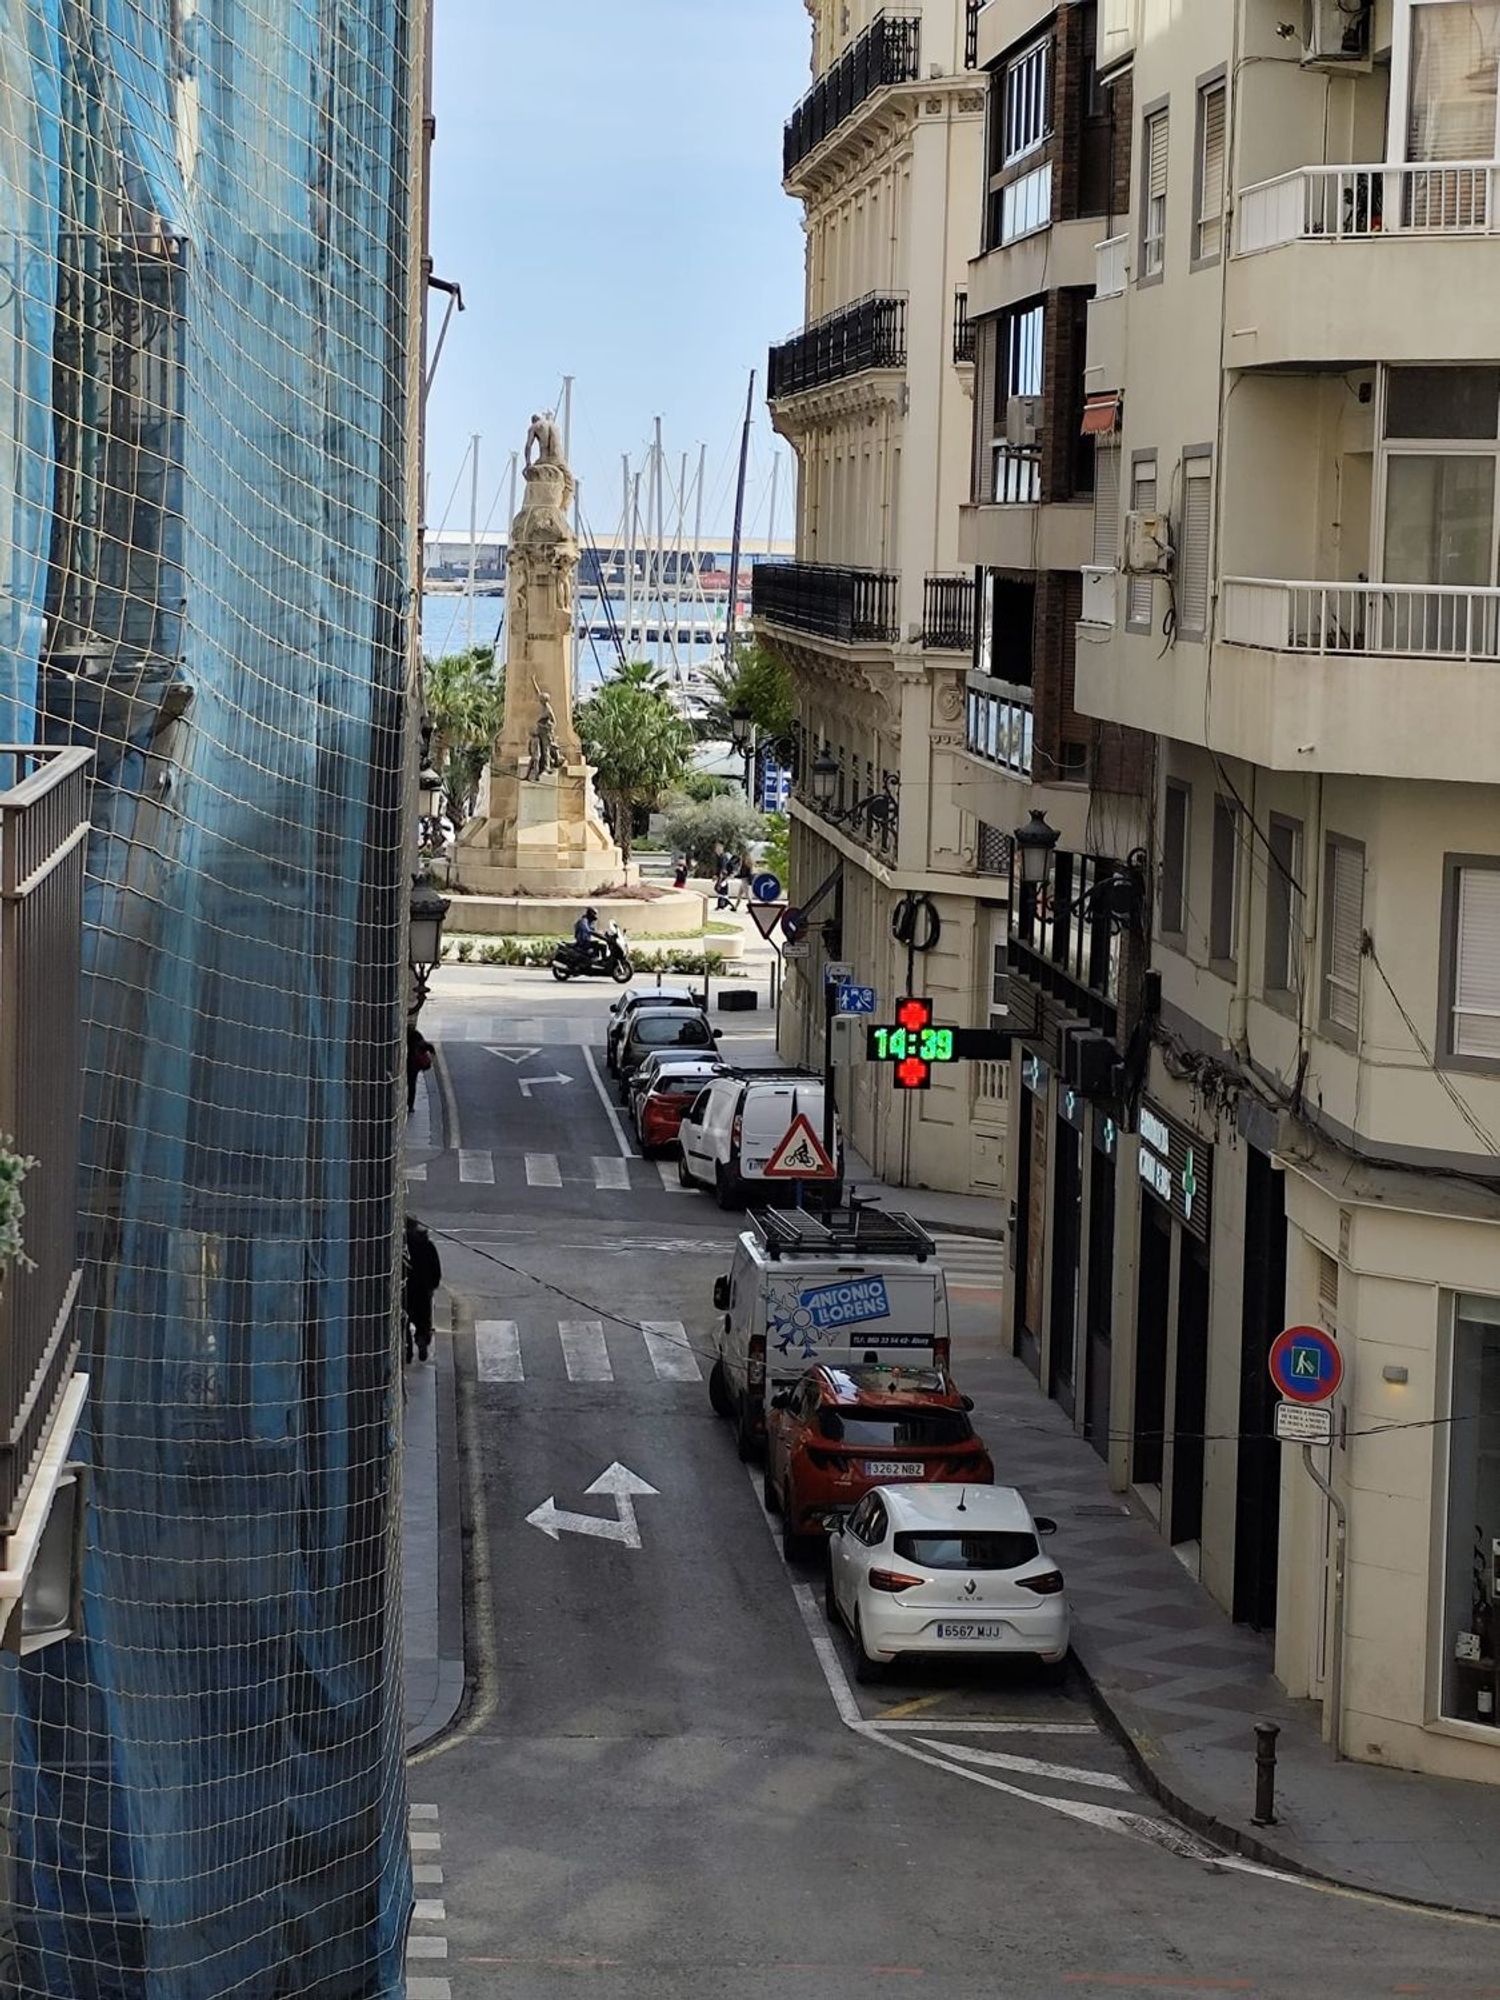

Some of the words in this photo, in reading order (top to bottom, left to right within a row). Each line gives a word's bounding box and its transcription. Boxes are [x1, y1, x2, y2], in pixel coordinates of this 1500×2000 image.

[874, 1027, 953, 1060] 14:39
[806, 1281, 884, 1309] ANTONIO
[818, 1297, 887, 1324] LLORENS
[873, 1464, 899, 1474] 3262
[901, 1464, 922, 1474] NBZ
[945, 1625, 973, 1637] 6567
[977, 1626, 1000, 1637] MJJ
